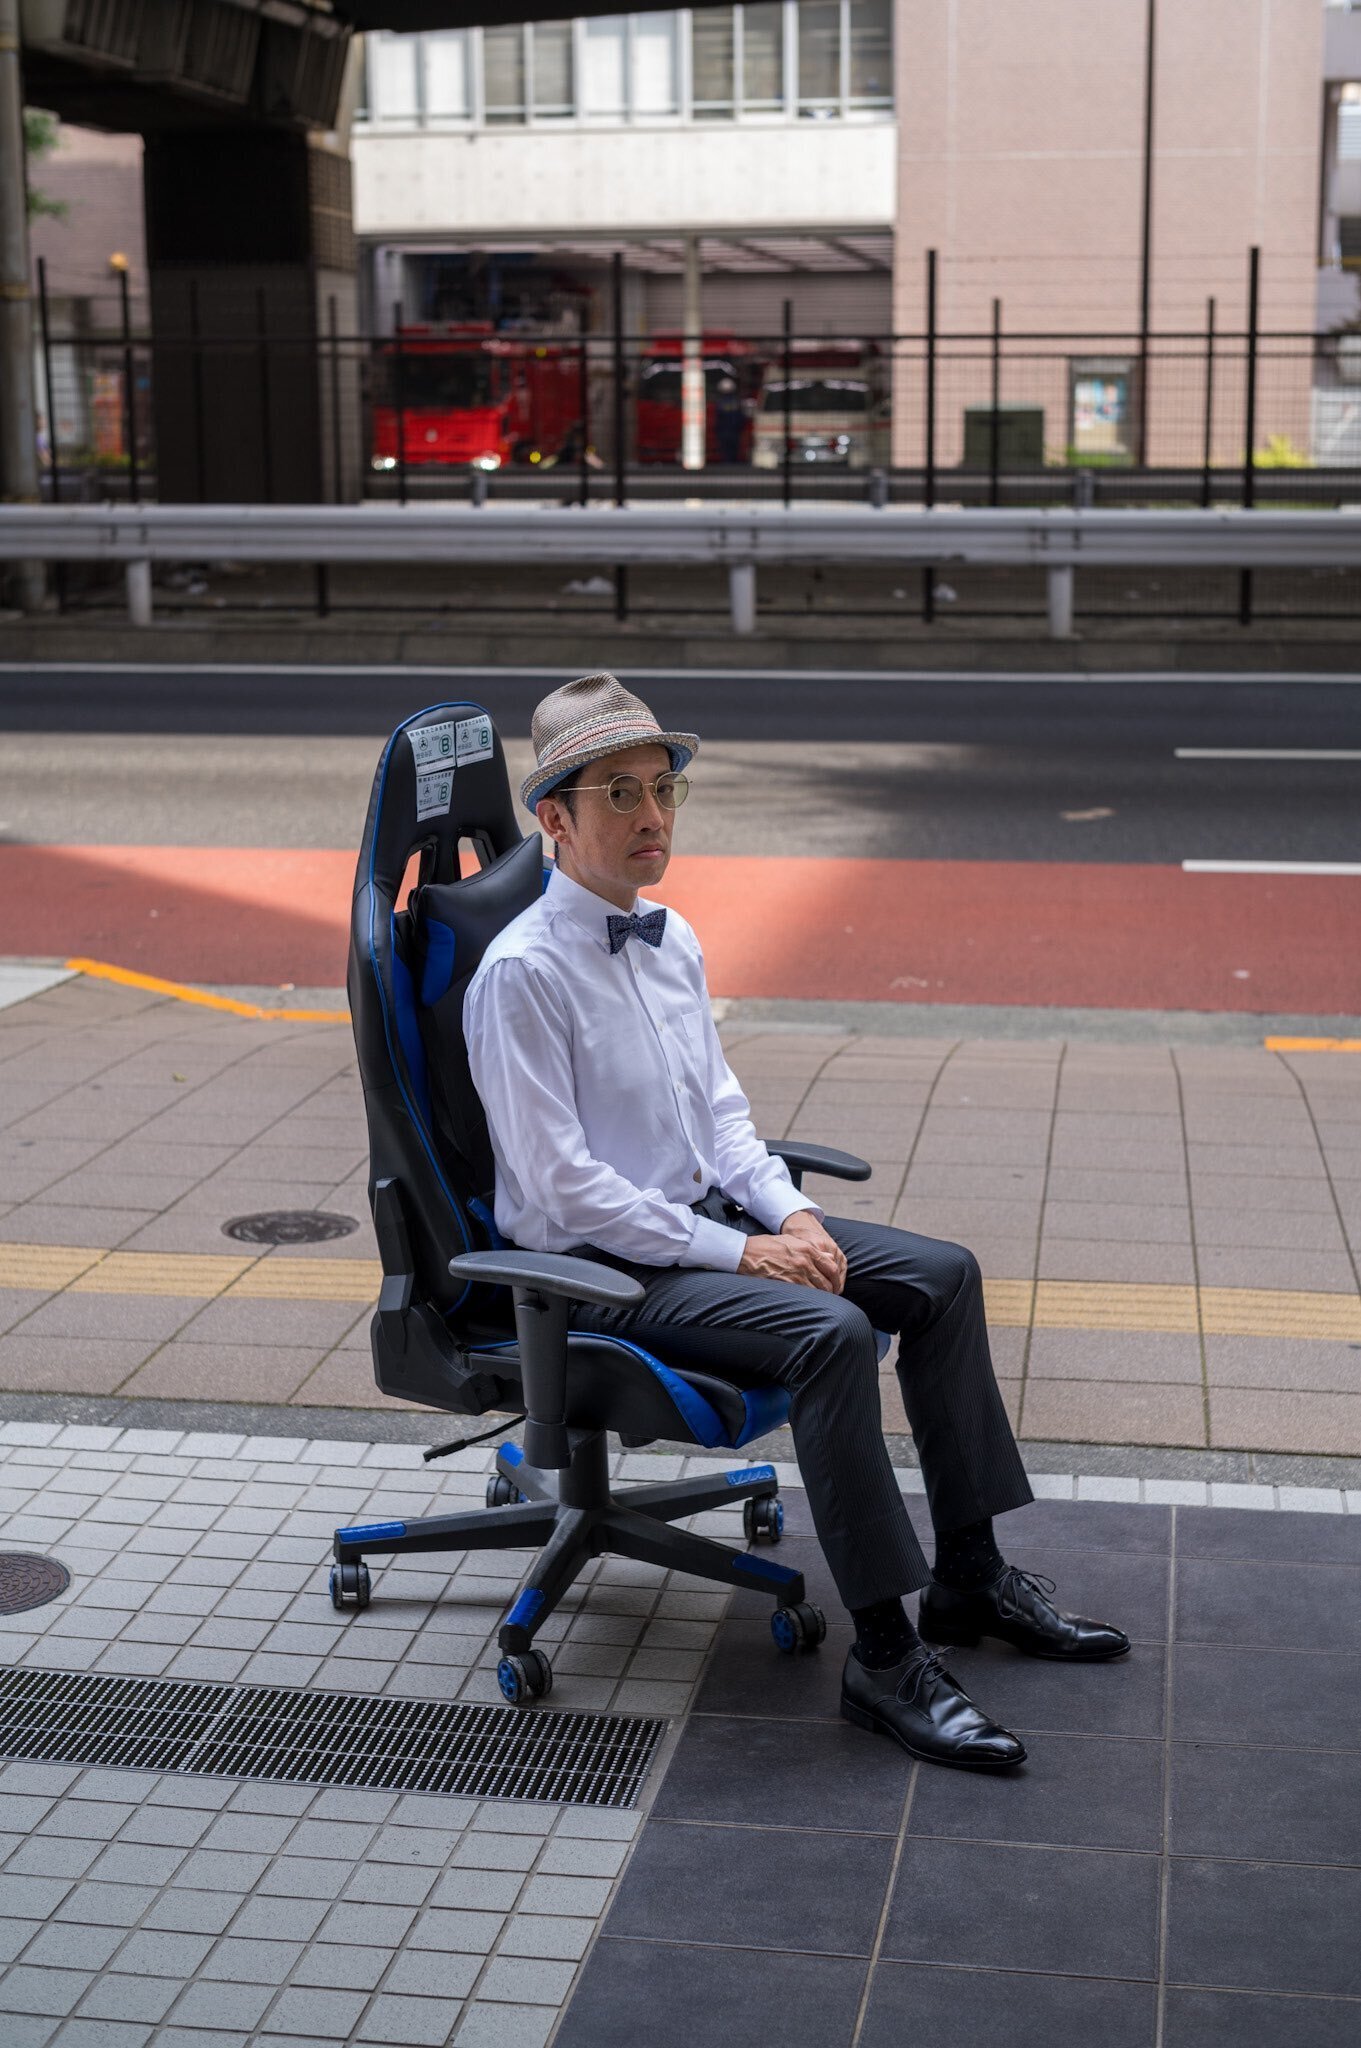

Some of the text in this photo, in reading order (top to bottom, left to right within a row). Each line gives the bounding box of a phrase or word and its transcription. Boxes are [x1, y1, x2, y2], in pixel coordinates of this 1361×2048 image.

[441, 737, 450, 752] B
[481, 730, 488, 745] B
[440, 785, 448, 800] B
